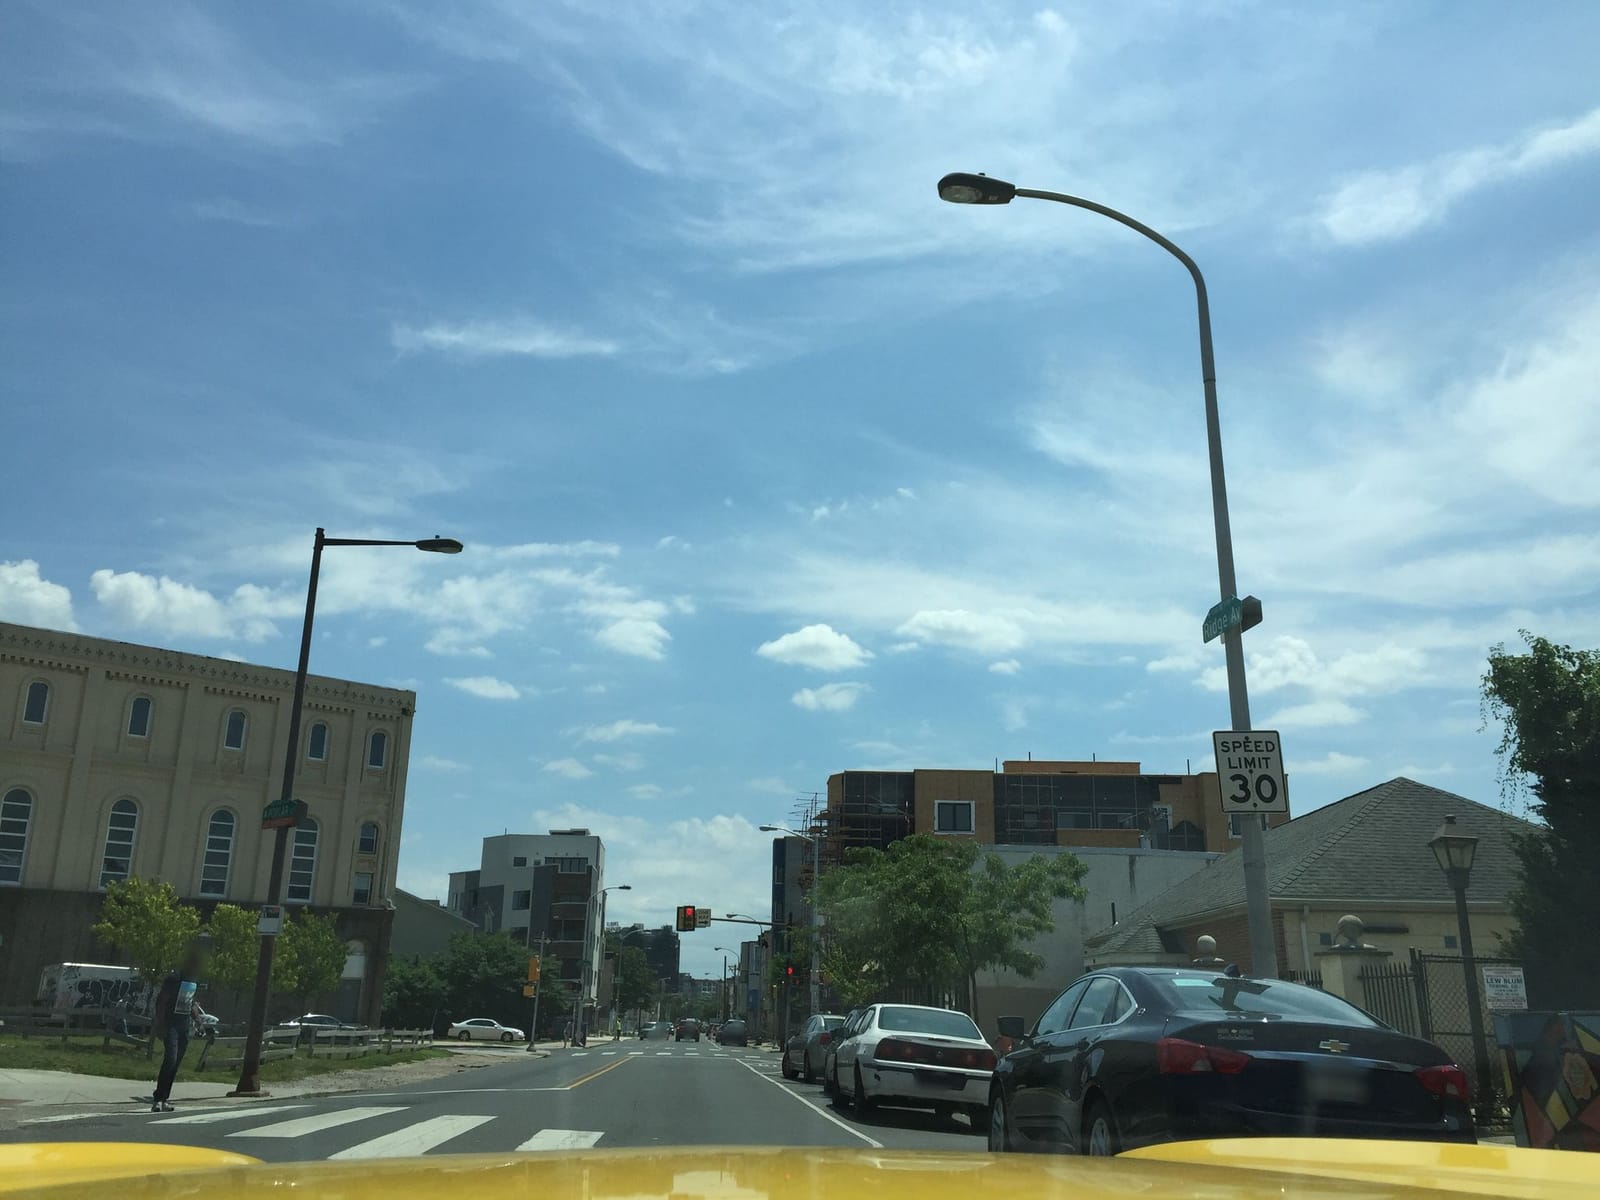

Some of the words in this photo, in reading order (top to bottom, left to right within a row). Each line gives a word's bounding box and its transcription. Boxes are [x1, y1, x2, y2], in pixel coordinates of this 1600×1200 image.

[1204, 614, 1228, 641] Ridge
[1220, 740, 1275, 753] SPEED
[1227, 756, 1271, 769] LIMIT
[1229, 773, 1278, 804] 30
